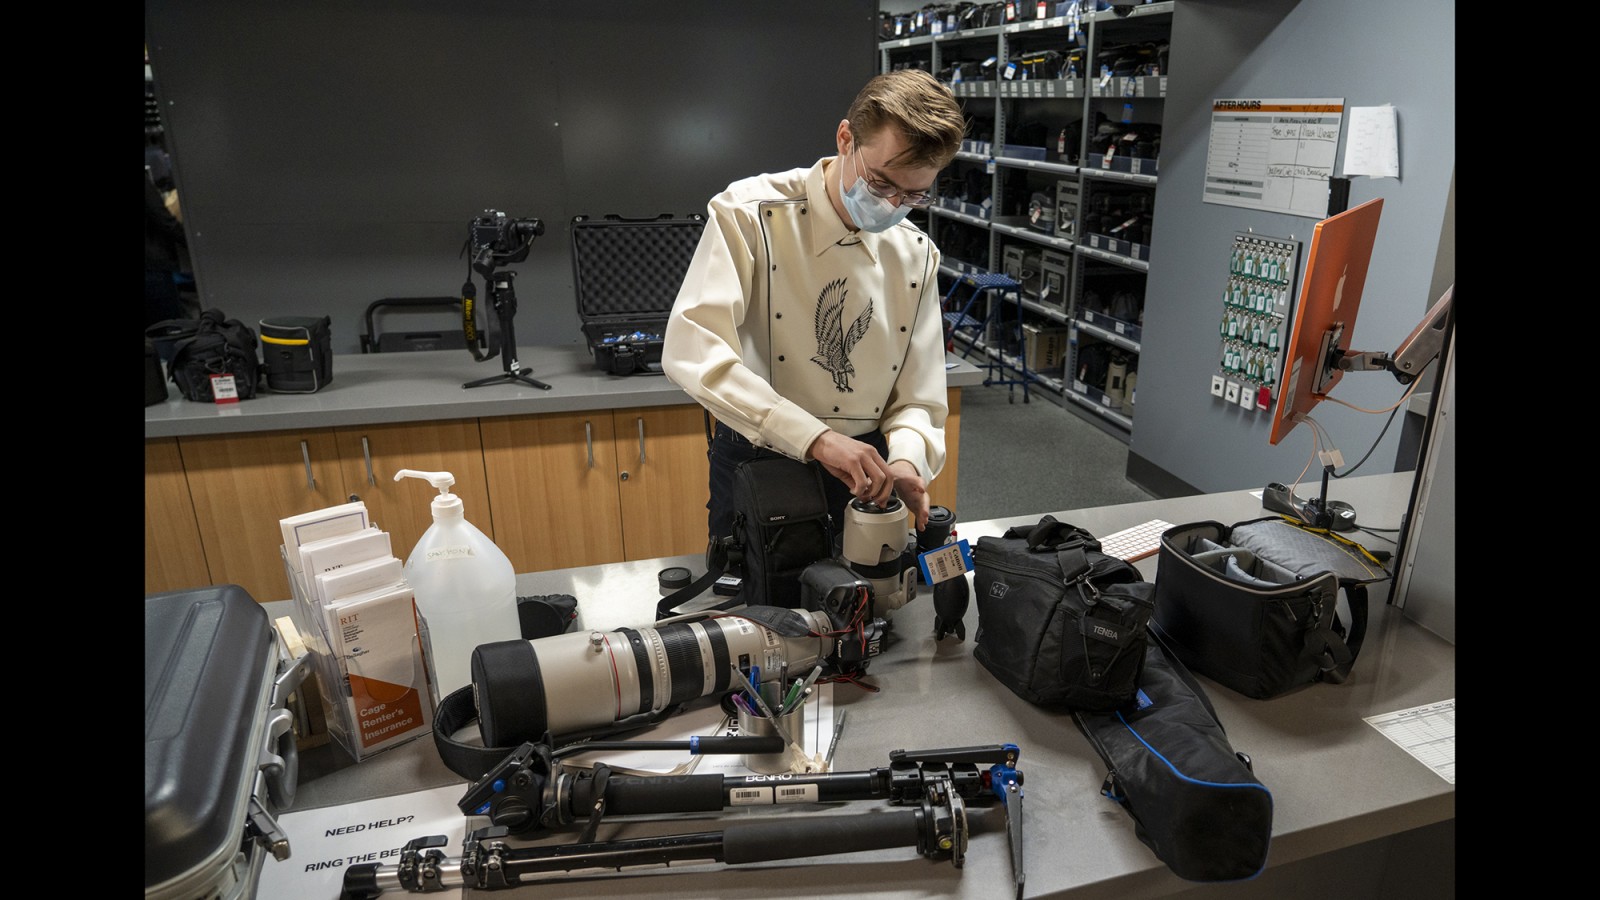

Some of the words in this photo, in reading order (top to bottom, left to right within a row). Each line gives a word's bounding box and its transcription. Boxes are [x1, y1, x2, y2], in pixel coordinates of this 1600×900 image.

[1214, 101, 1236, 110] AFTER
[1236, 100, 1262, 110] HOURS
[1046, 336, 1055, 365] Nikon
[953, 548, 963, 571] Canon
[340, 613, 359, 625] RIT
[1093, 625, 1118, 640] TENBA
[360, 703, 386, 717] Cage
[362, 708, 404, 729] Renter's
[364, 717, 413, 740] Insurance
[325, 824, 366, 837] NEED
[368, 815, 415, 830] HELP?
[304, 858, 344, 872] RING
[346, 852, 378, 865] THE
[379, 848, 403, 859] BE
